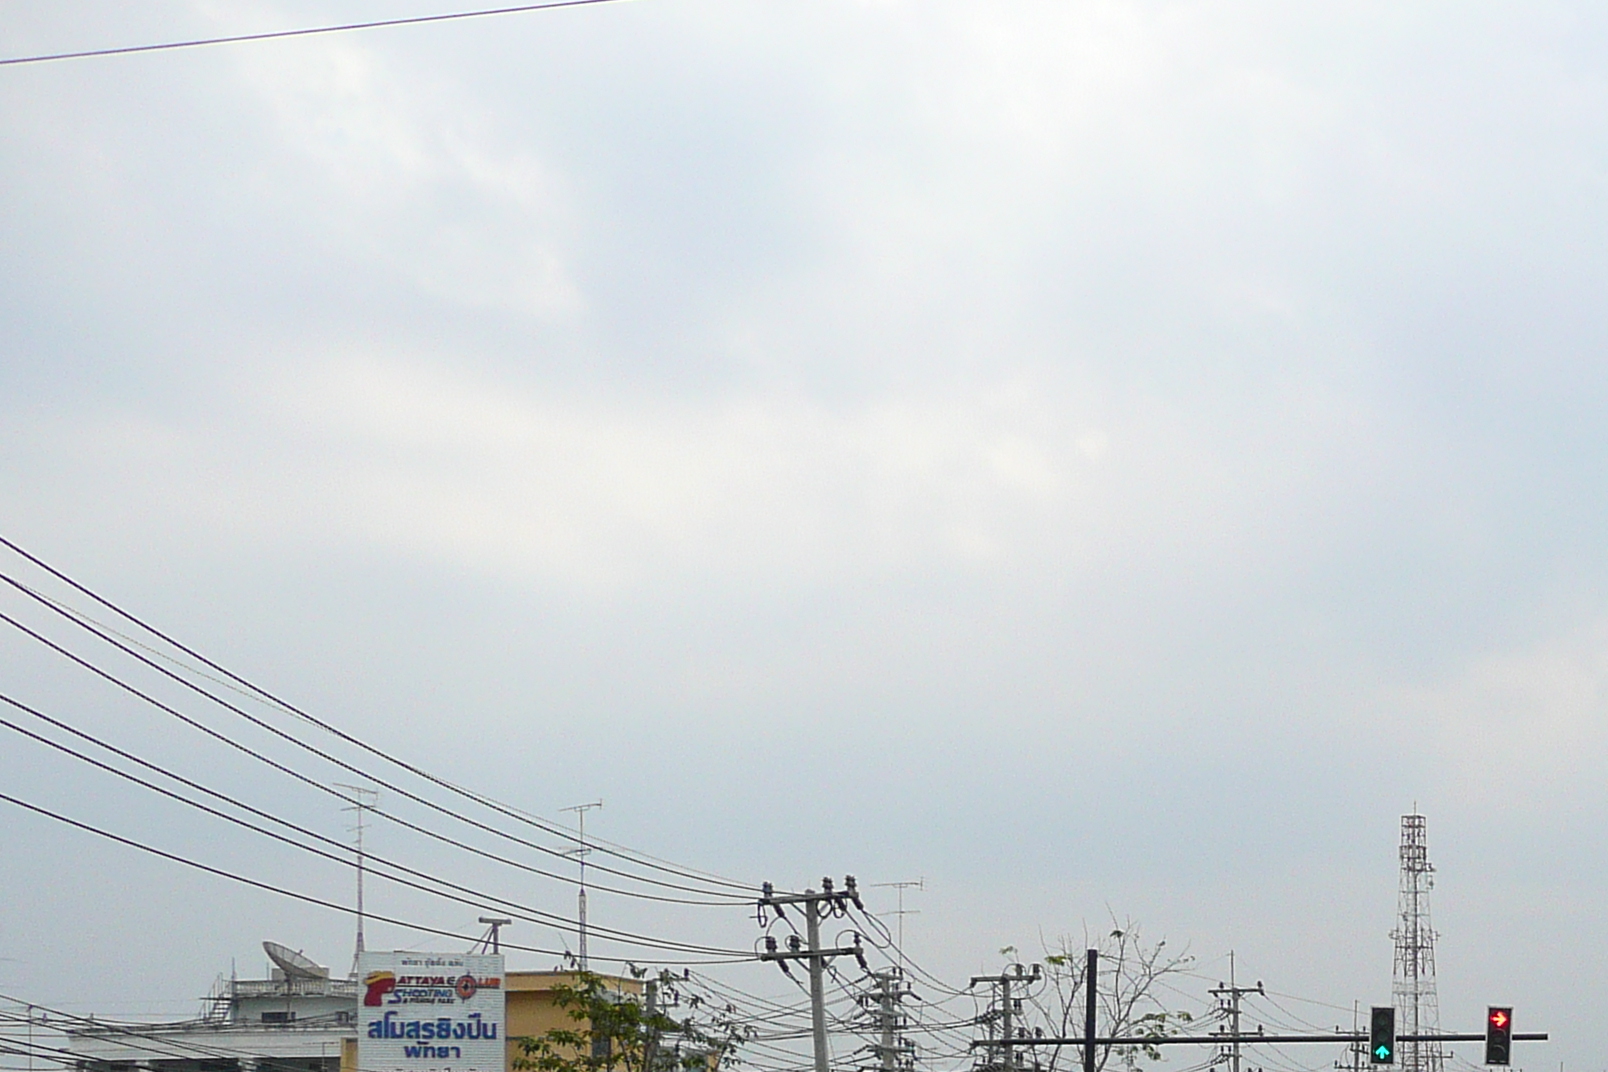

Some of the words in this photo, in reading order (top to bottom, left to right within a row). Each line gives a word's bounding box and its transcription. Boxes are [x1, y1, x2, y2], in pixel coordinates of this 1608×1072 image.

[367, 1011, 498, 1039] สโมสรยิงปืน
[404, 1041, 461, 1059] พัทยา
